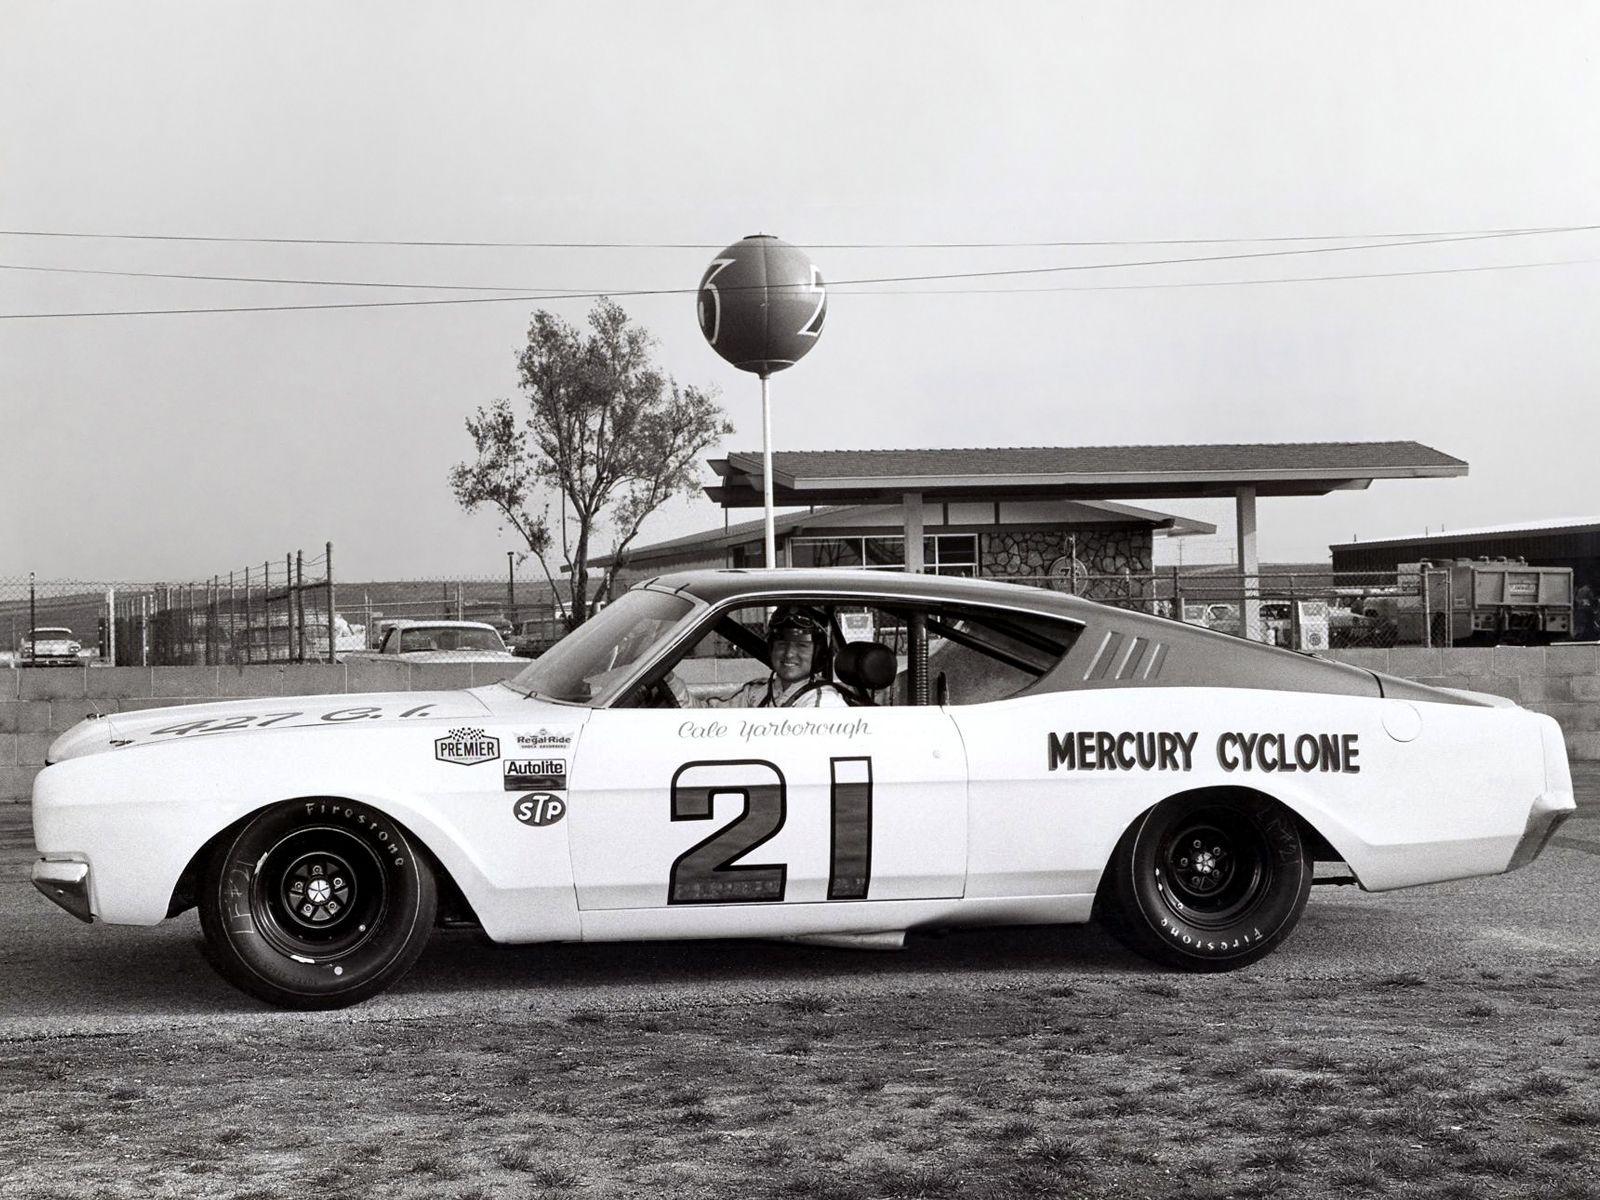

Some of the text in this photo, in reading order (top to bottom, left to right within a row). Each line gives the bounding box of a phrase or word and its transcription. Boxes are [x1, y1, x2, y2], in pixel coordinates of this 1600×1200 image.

[149, 711, 304, 736] 427
[678, 718, 873, 743] Cale Yarborough
[440, 741, 495, 757] PREMIER
[1048, 731, 1361, 774] MERCURY CYCLONE
[507, 760, 563, 774] Autolite
[517, 795, 562, 823] STP
[667, 756, 874, 906] 21
